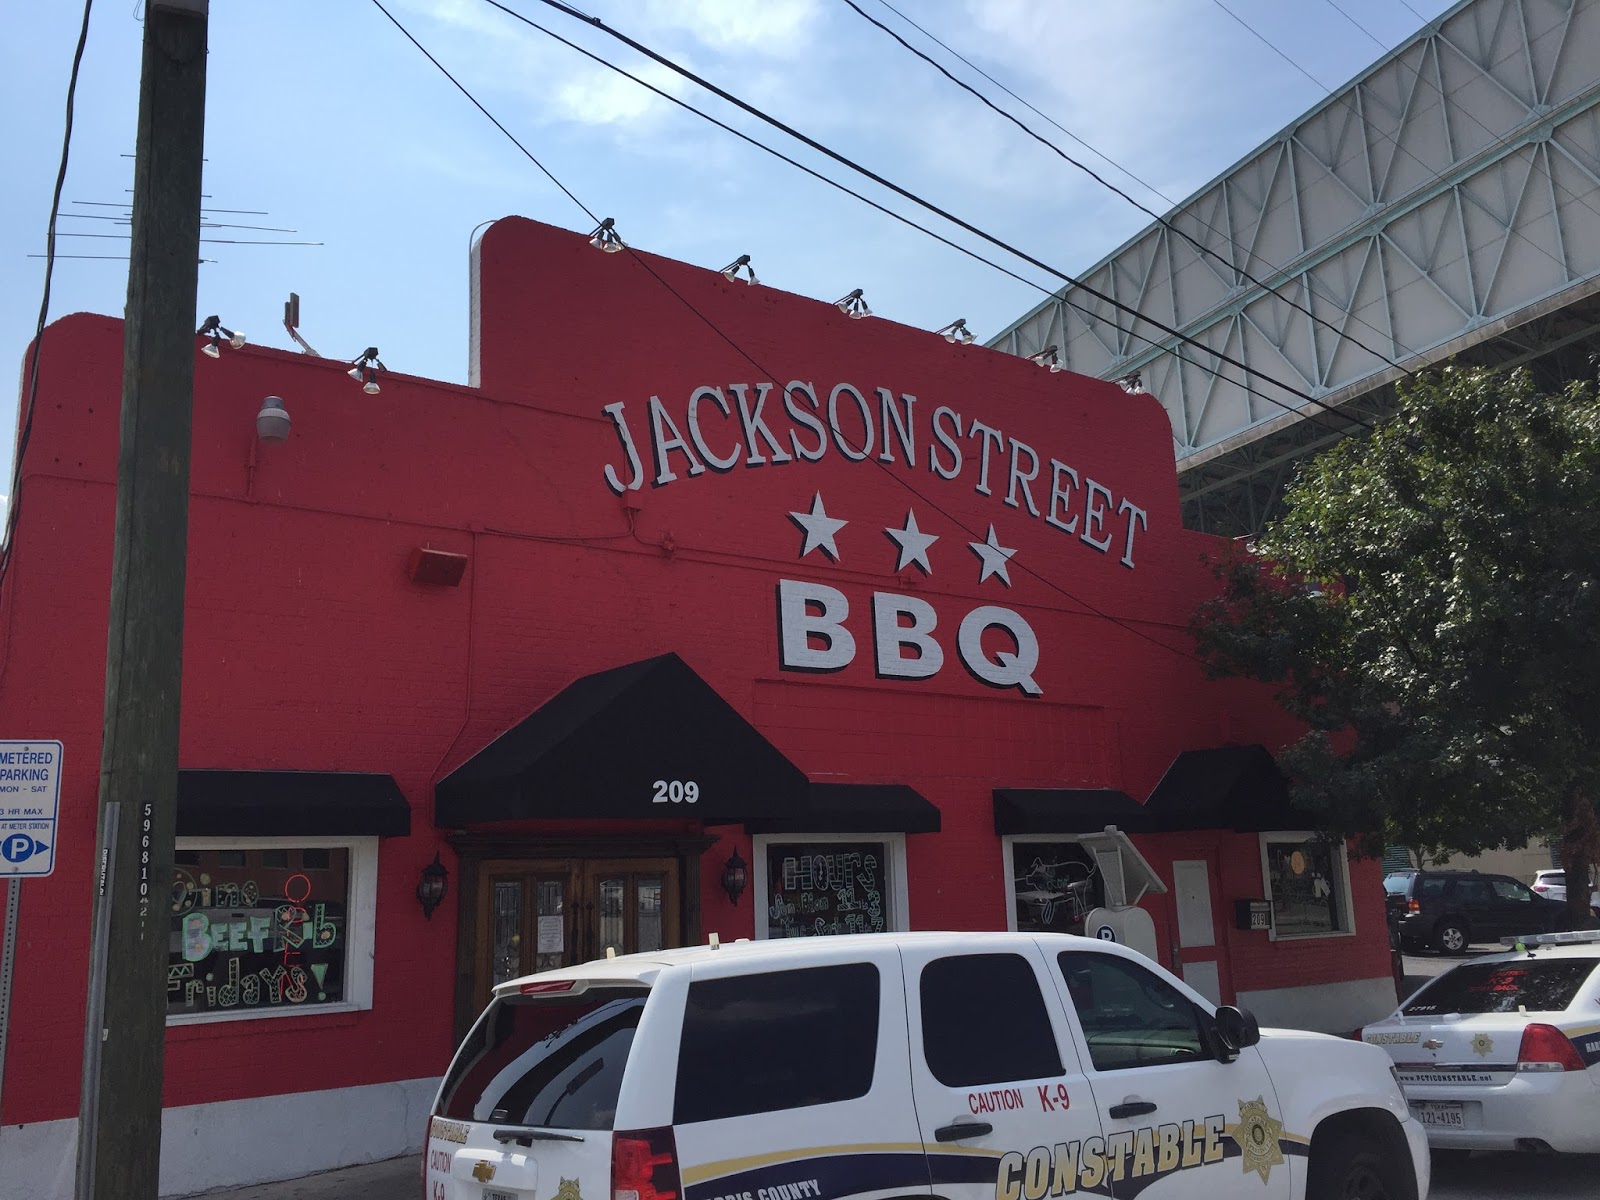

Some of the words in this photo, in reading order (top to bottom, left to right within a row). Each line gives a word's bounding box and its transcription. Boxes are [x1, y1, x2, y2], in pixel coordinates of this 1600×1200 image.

[602, 379, 918, 494] JACKSON
[928, 405, 1148, 570] STREET
[776, 578, 1044, 697] BBQ
[0, 752, 53, 764] METERED
[0, 768, 49, 781] PARKING
[0, 785, 19, 793] MON
[31, 785, 48, 793] SAT
[652, 780, 700, 804] 209
[0, 808, 5, 816] 3
[8, 808, 20, 816] HR
[23, 808, 43, 816] MAX
[1, 822, 8, 830] AT
[9, 822, 28, 830] METER
[28, 822, 50, 830] STATION
[10, 838, 30, 859] P
[868, 890, 881, 917] 3
[1251, 913, 1266, 926] 209
[1366, 1031, 1422, 1044] CONSTABLE
[968, 1088, 1024, 1115] CAUTION
[1037, 1083, 1070, 1113] K-9
[430, 1149, 452, 1174] CAUTION
[994, 1114, 1226, 1200] CONSTABLE
[757, 1178, 822, 1200] COUNTY
